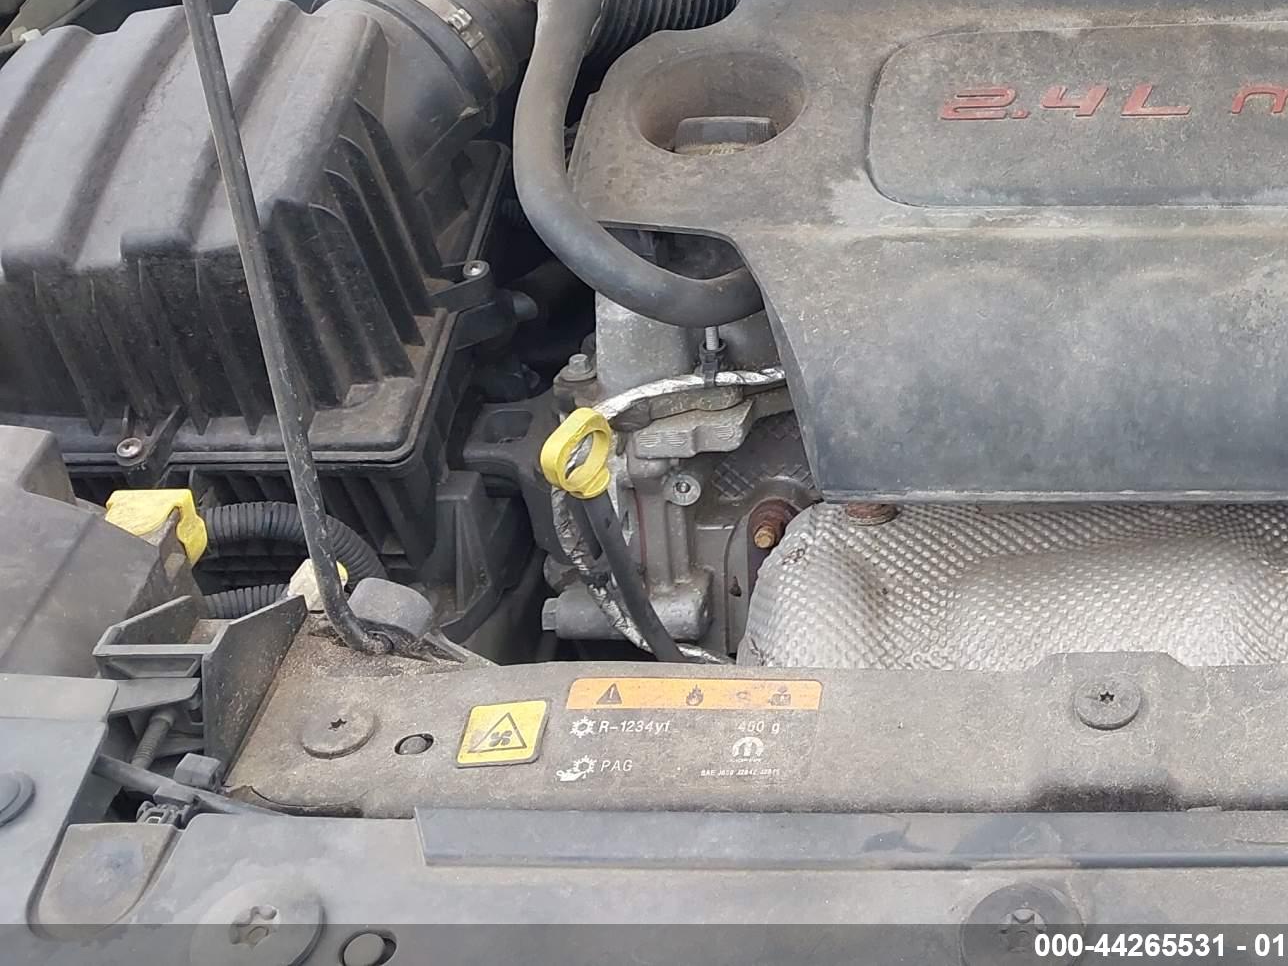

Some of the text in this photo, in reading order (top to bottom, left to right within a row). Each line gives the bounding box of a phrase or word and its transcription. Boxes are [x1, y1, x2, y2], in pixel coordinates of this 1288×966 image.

[598, 720, 671, 735] R-1234yf
[770, 722, 780, 735] g
[600, 759, 633, 772] PAG
